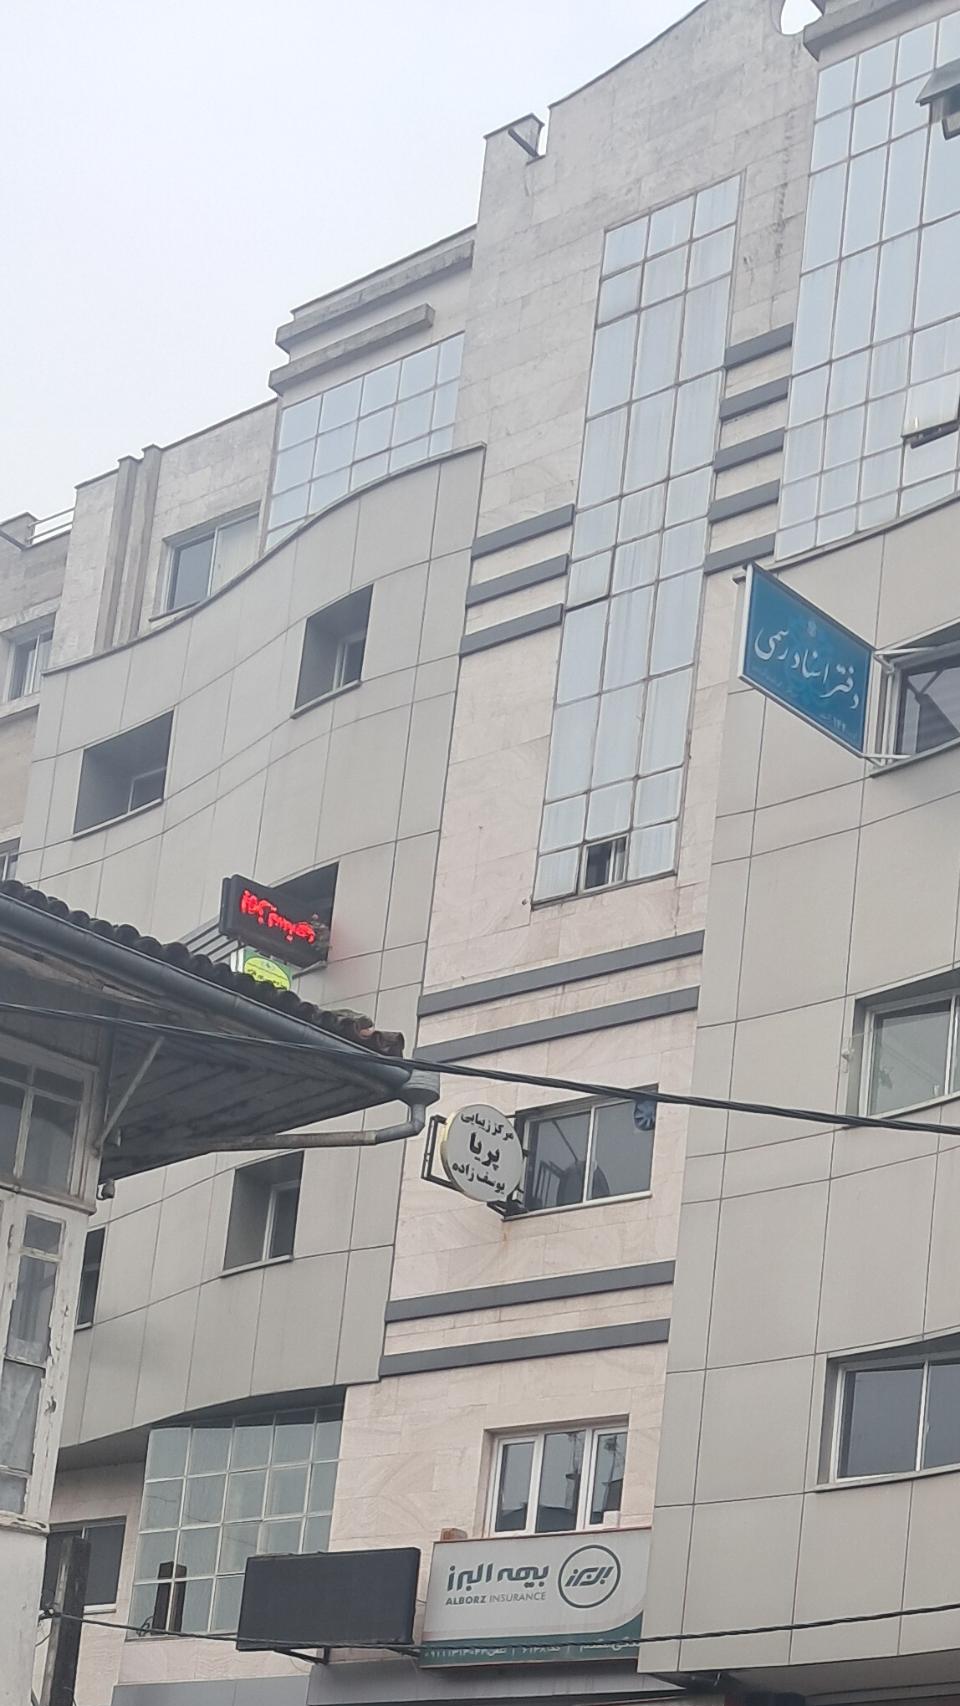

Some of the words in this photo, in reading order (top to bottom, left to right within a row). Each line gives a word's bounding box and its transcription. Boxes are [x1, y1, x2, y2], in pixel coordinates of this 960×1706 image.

[790, 650, 831, 685] اسناد
[819, 665, 860, 709] دفتر
[447, 1563, 494, 1592] البرز
[497, 1565, 549, 1588] بیمه
[445, 1594, 487, 1606] ALBORZ
[489, 1591, 547, 1603] INSURANCE
